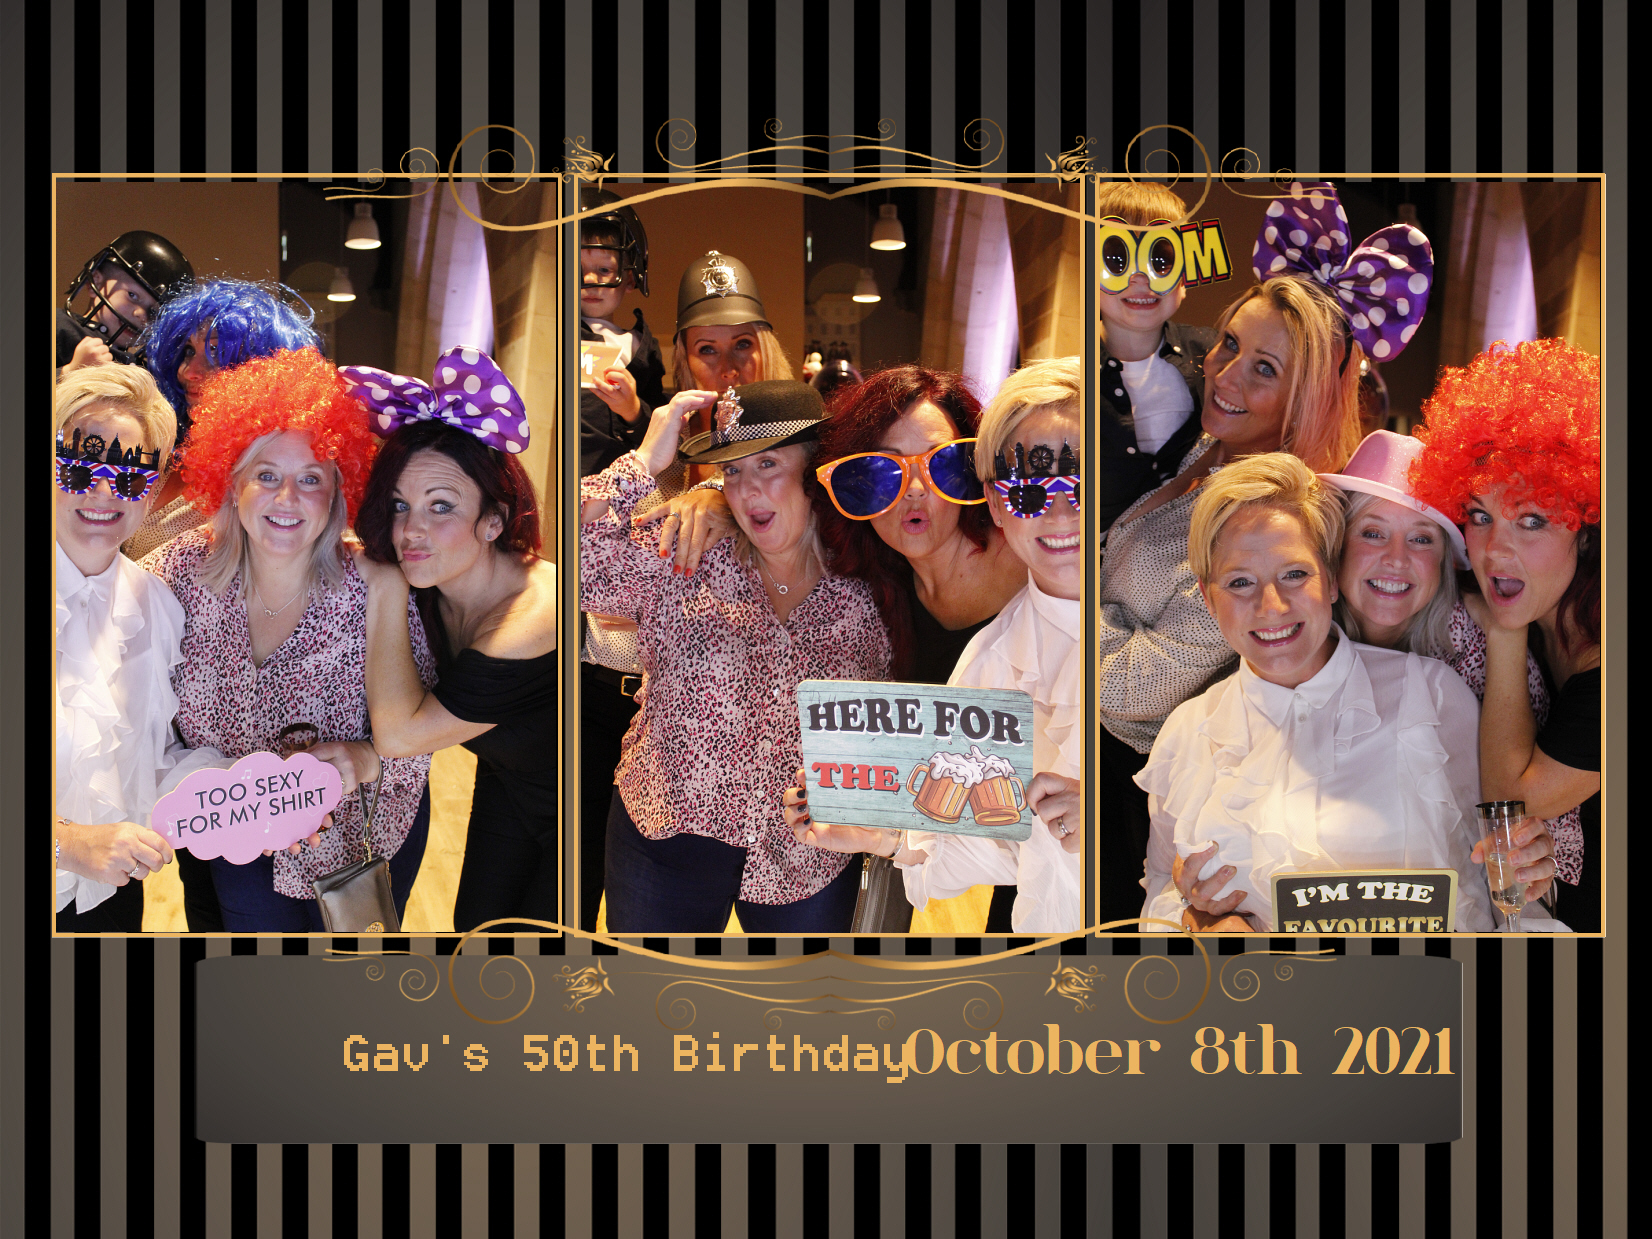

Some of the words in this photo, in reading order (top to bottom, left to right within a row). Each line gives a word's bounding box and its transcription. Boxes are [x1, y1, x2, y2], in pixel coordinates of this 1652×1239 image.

[807, 698, 924, 736] HERE
[933, 701, 1025, 746] FOR
[195, 783, 246, 809] TOO
[255, 769, 304, 796] SEXY
[811, 761, 900, 791] THE
[176, 812, 222, 838] FOR
[229, 802, 261, 825] MY
[269, 787, 326, 815] SHIRT
[1291, 883, 1350, 907] I'M
[1357, 881, 1435, 904] THE
[1283, 916, 1444, 932] FAVOURITE
